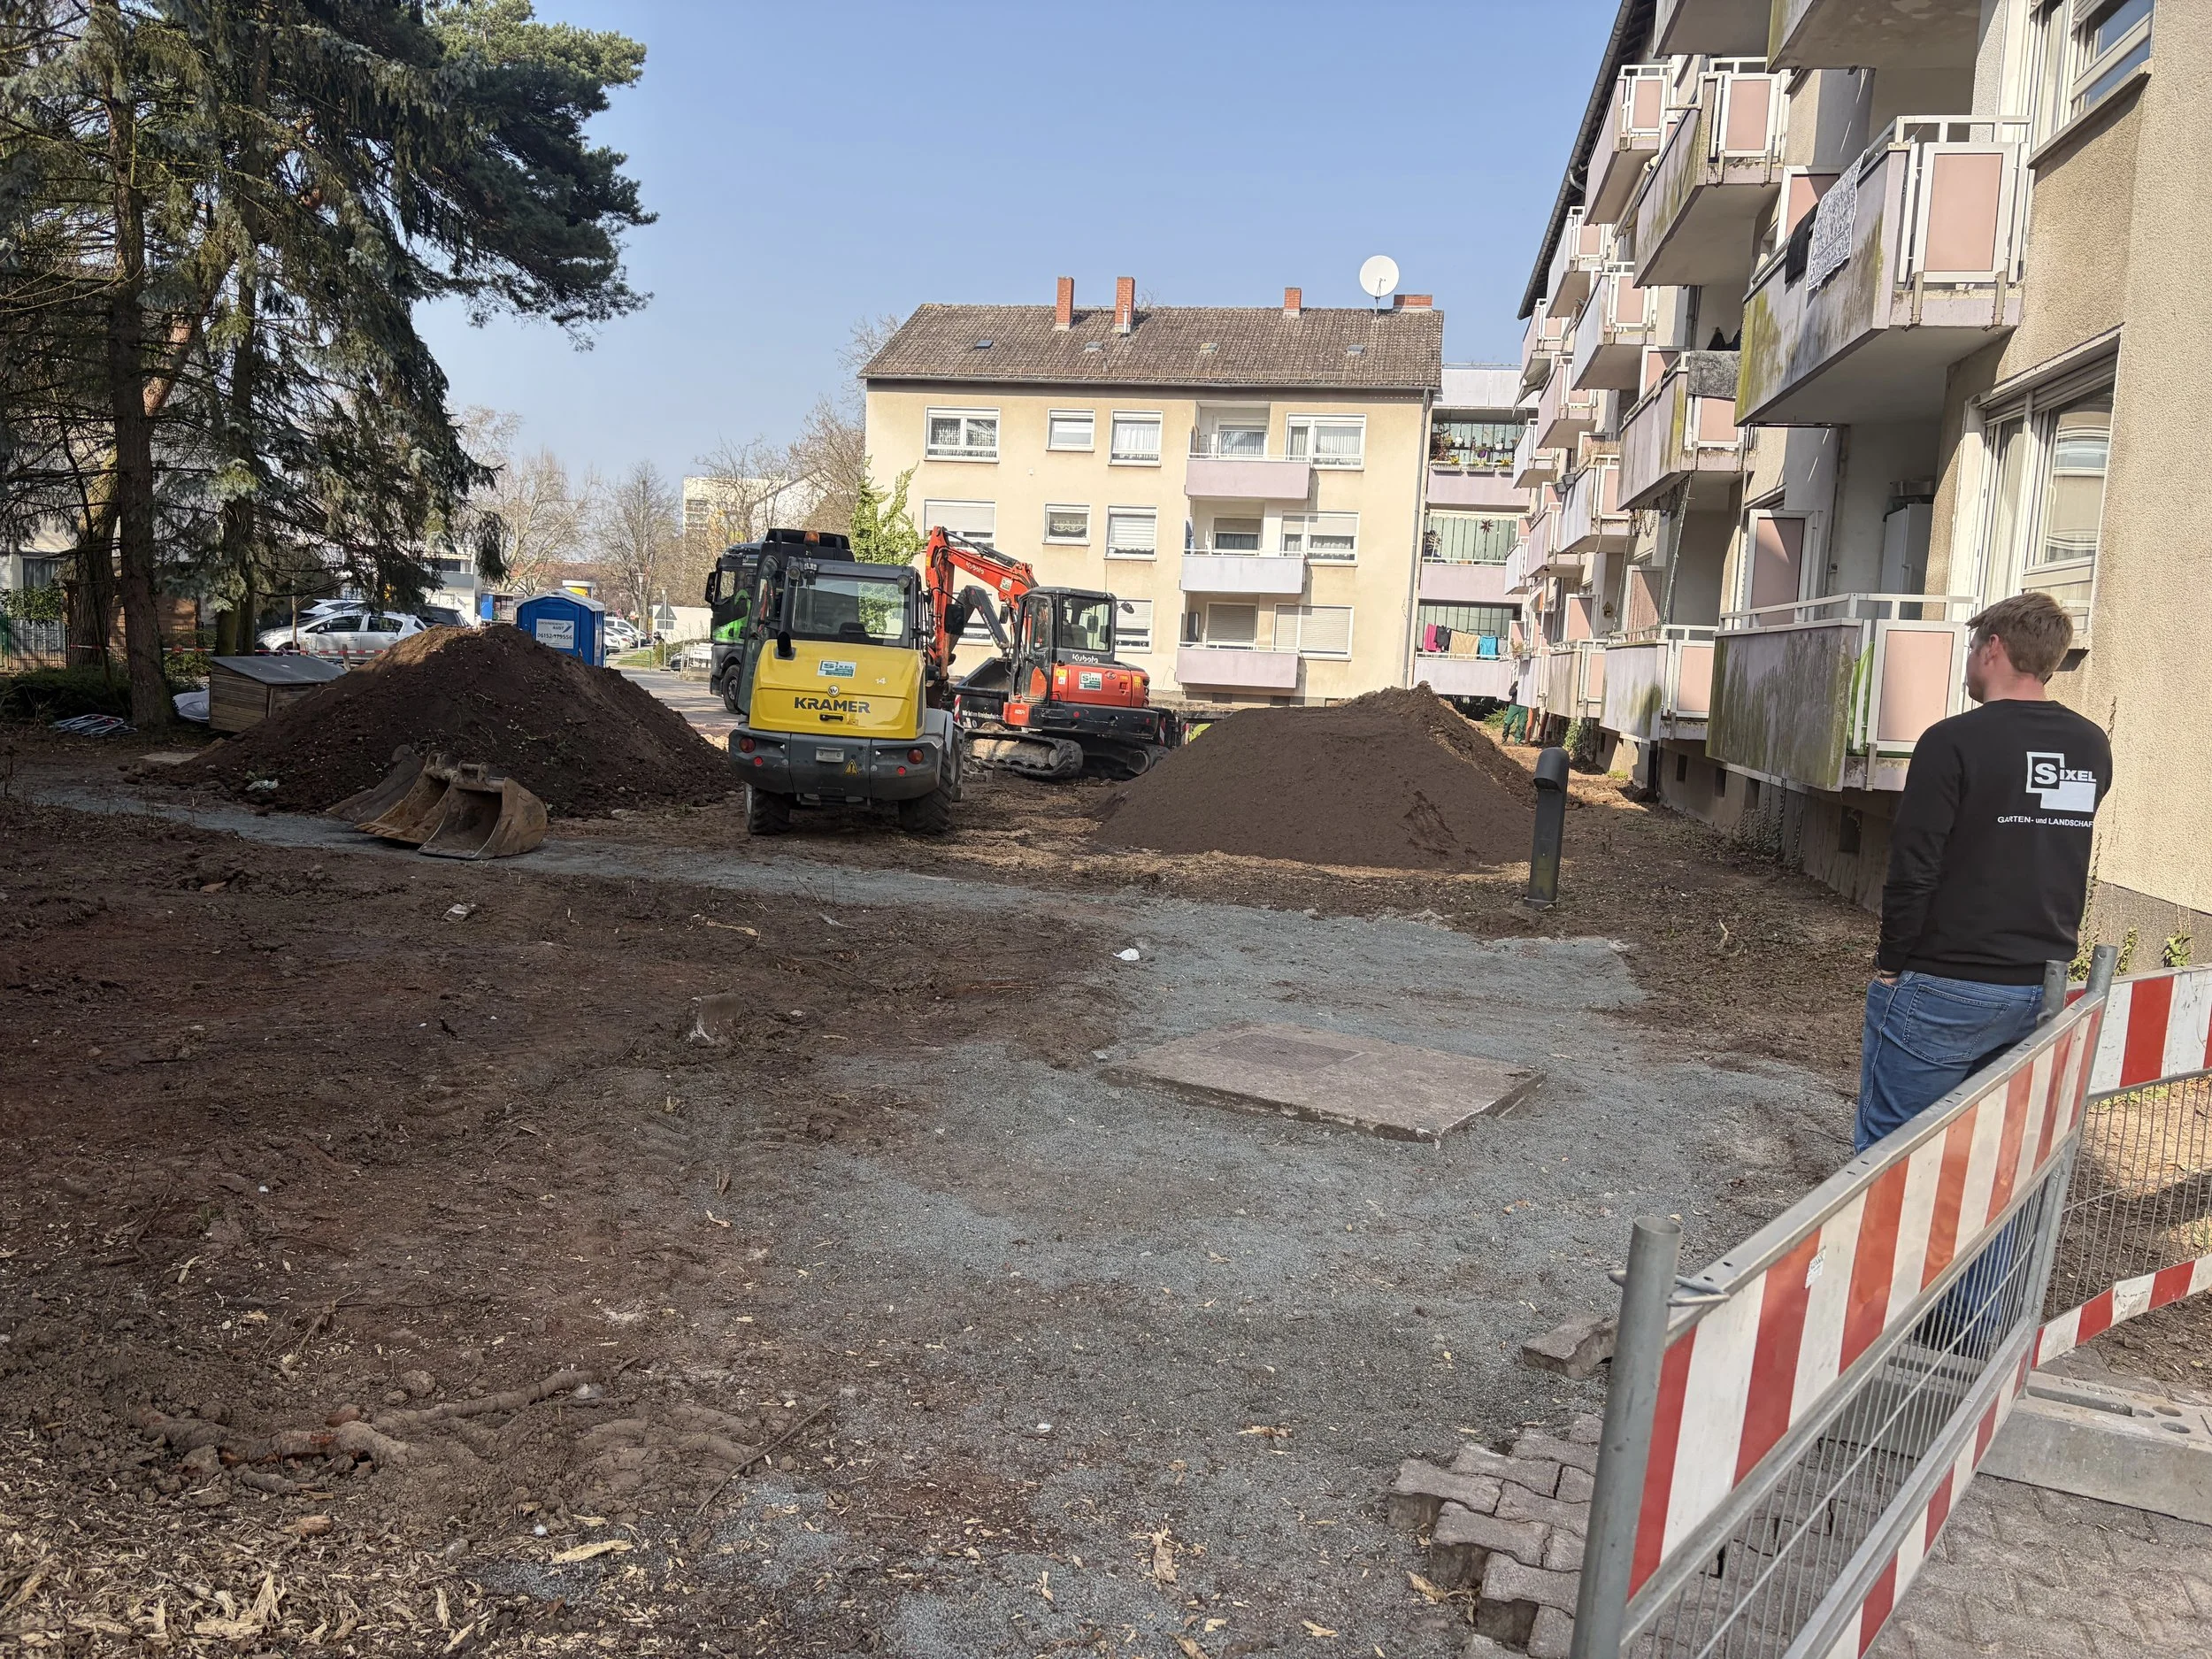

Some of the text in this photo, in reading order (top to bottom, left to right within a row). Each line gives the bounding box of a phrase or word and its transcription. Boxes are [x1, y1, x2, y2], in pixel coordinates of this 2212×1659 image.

[1071, 653, 1099, 664] Kubota
[794, 696, 871, 714] KRAMER
[1997, 815, 2034, 824] GARTEN-
